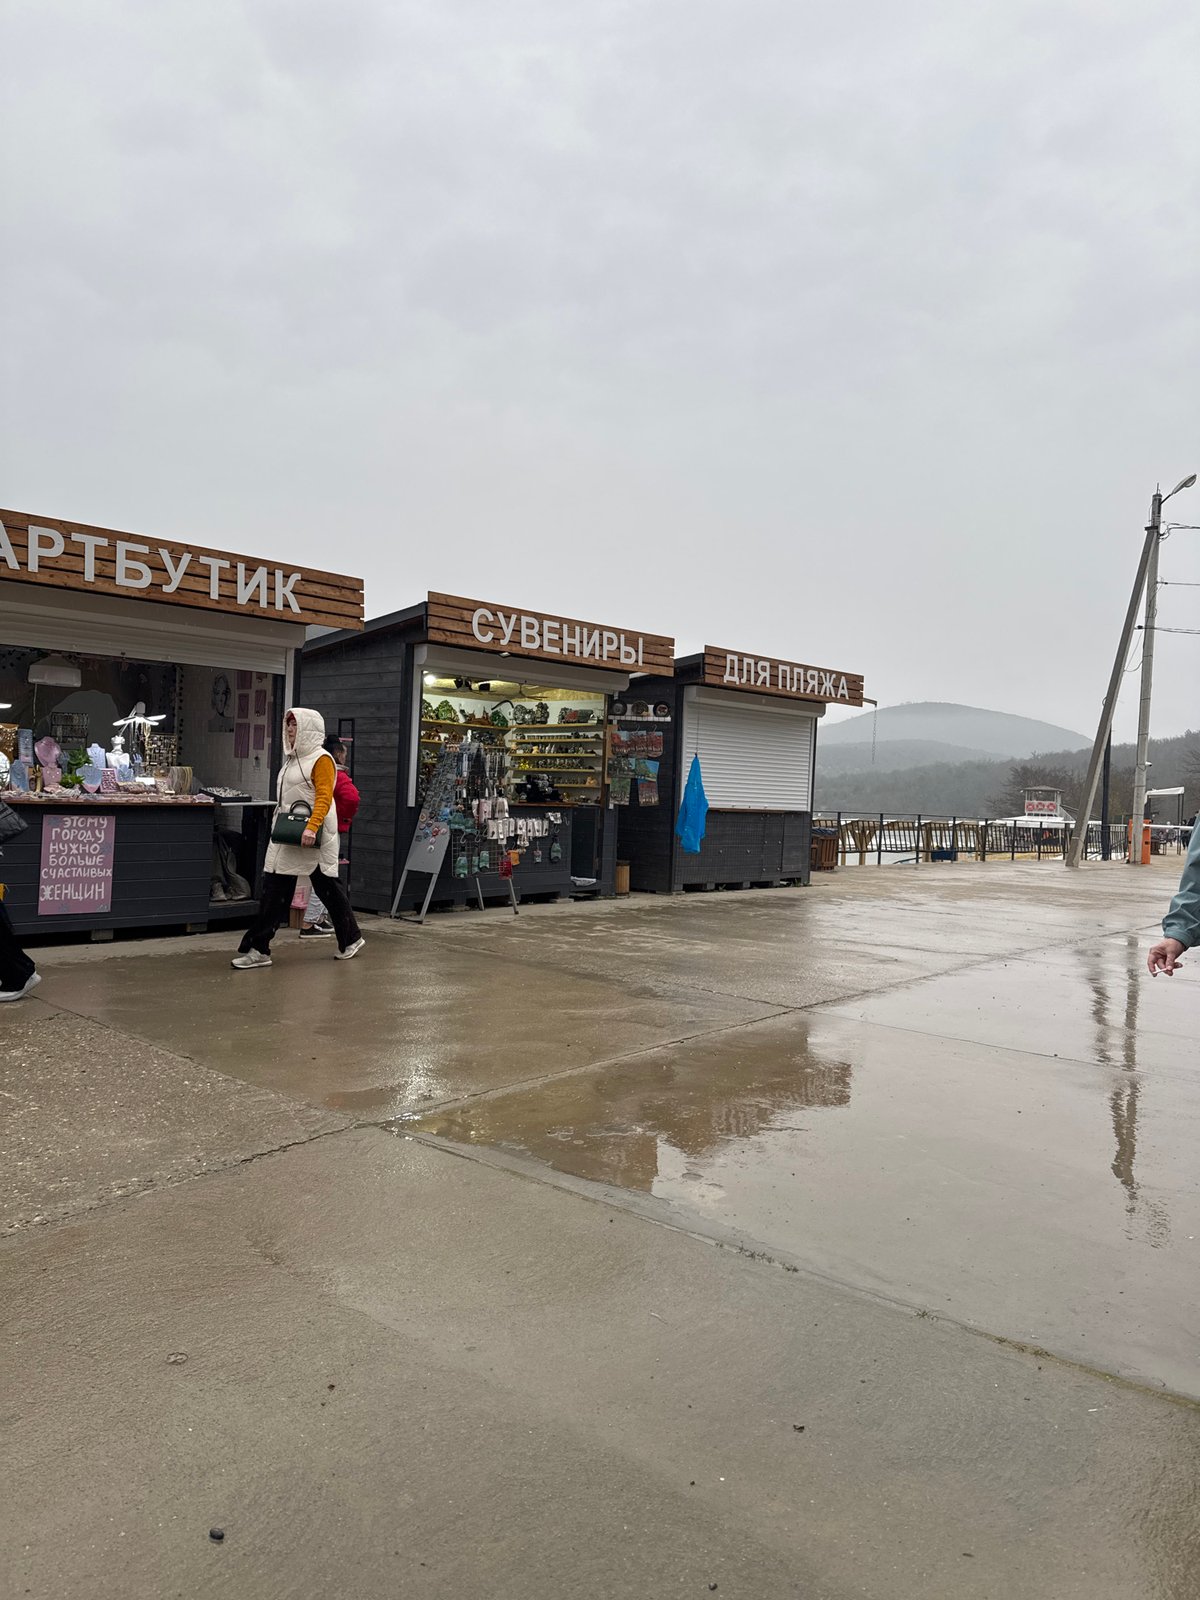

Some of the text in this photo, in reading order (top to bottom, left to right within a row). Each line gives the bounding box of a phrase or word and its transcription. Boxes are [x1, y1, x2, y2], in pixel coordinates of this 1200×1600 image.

[472, 607, 643, 667] СУВЕНИРЫ
[723, 653, 849, 700] ДЛЯ ПЛЯЖА
[63, 816, 107, 828] ЭТОМУ
[52, 828, 105, 843] ГОРОДУ
[49, 842, 100, 854] НУЖНО
[49, 854, 104, 866] БОЛЬШЕ
[41, 867, 112, 878] СЧАСТЛИВЫХ
[40, 882, 105, 901] ЖЕНЩИН
